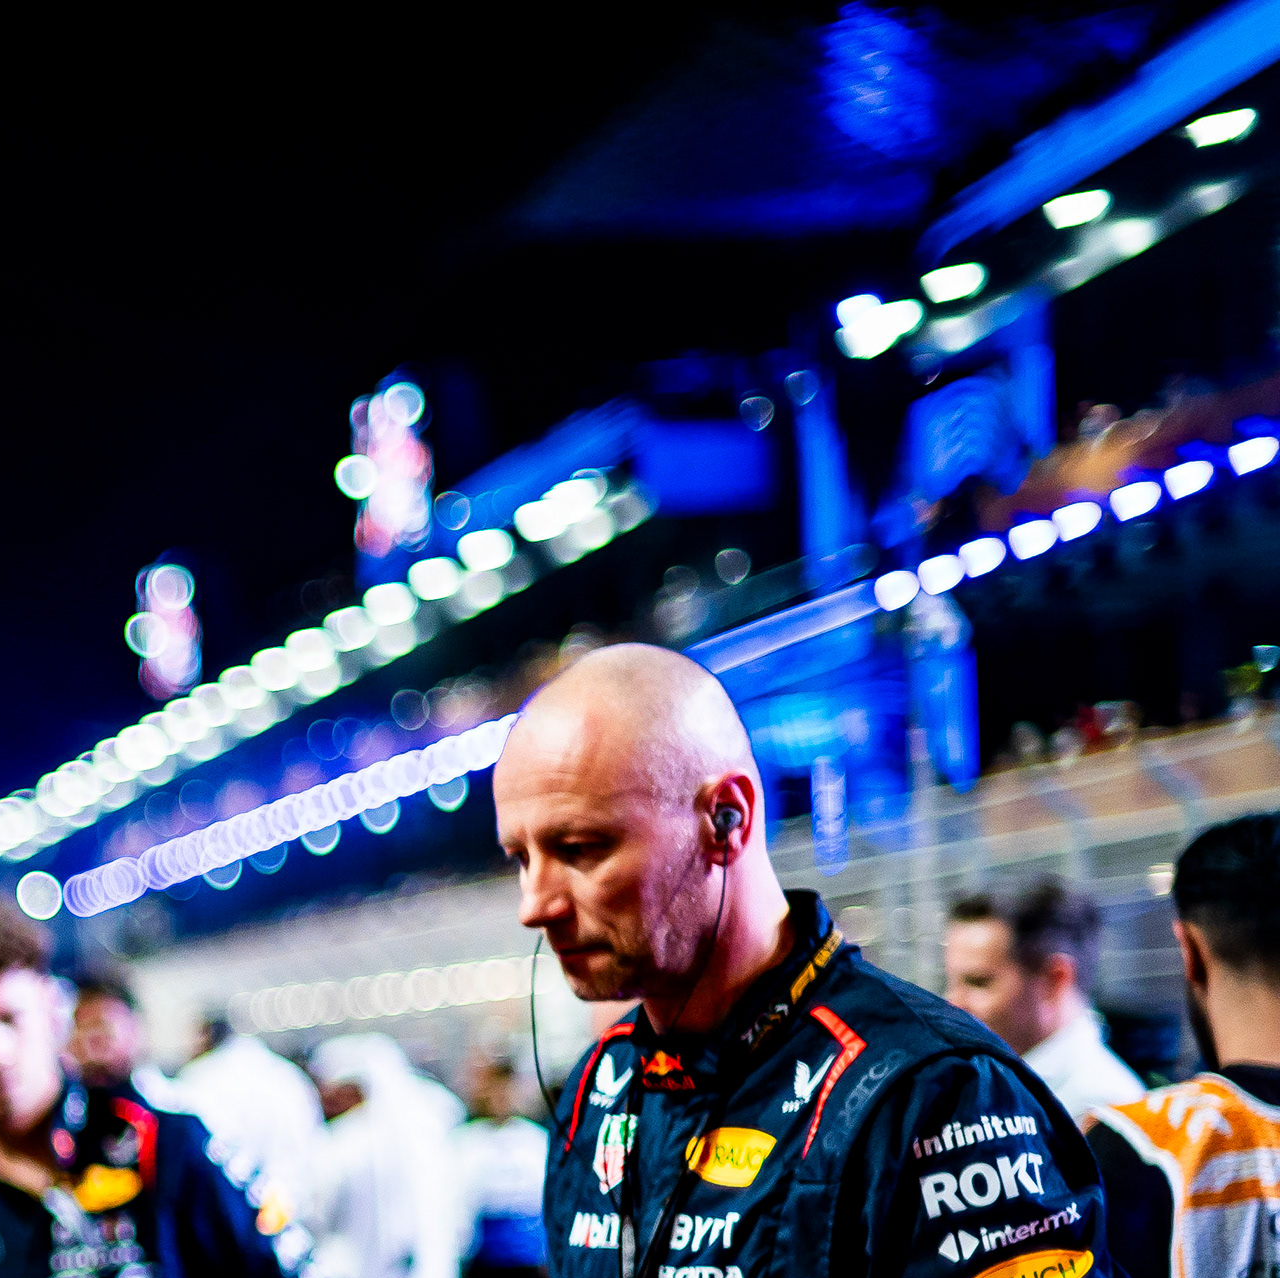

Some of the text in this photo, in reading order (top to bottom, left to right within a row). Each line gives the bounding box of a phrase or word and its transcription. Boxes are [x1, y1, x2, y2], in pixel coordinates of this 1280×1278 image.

[715, 1141, 766, 1171] RAUC
[919, 1152, 1045, 1220] ROKT
[980, 1201, 1082, 1253] inter.mx
